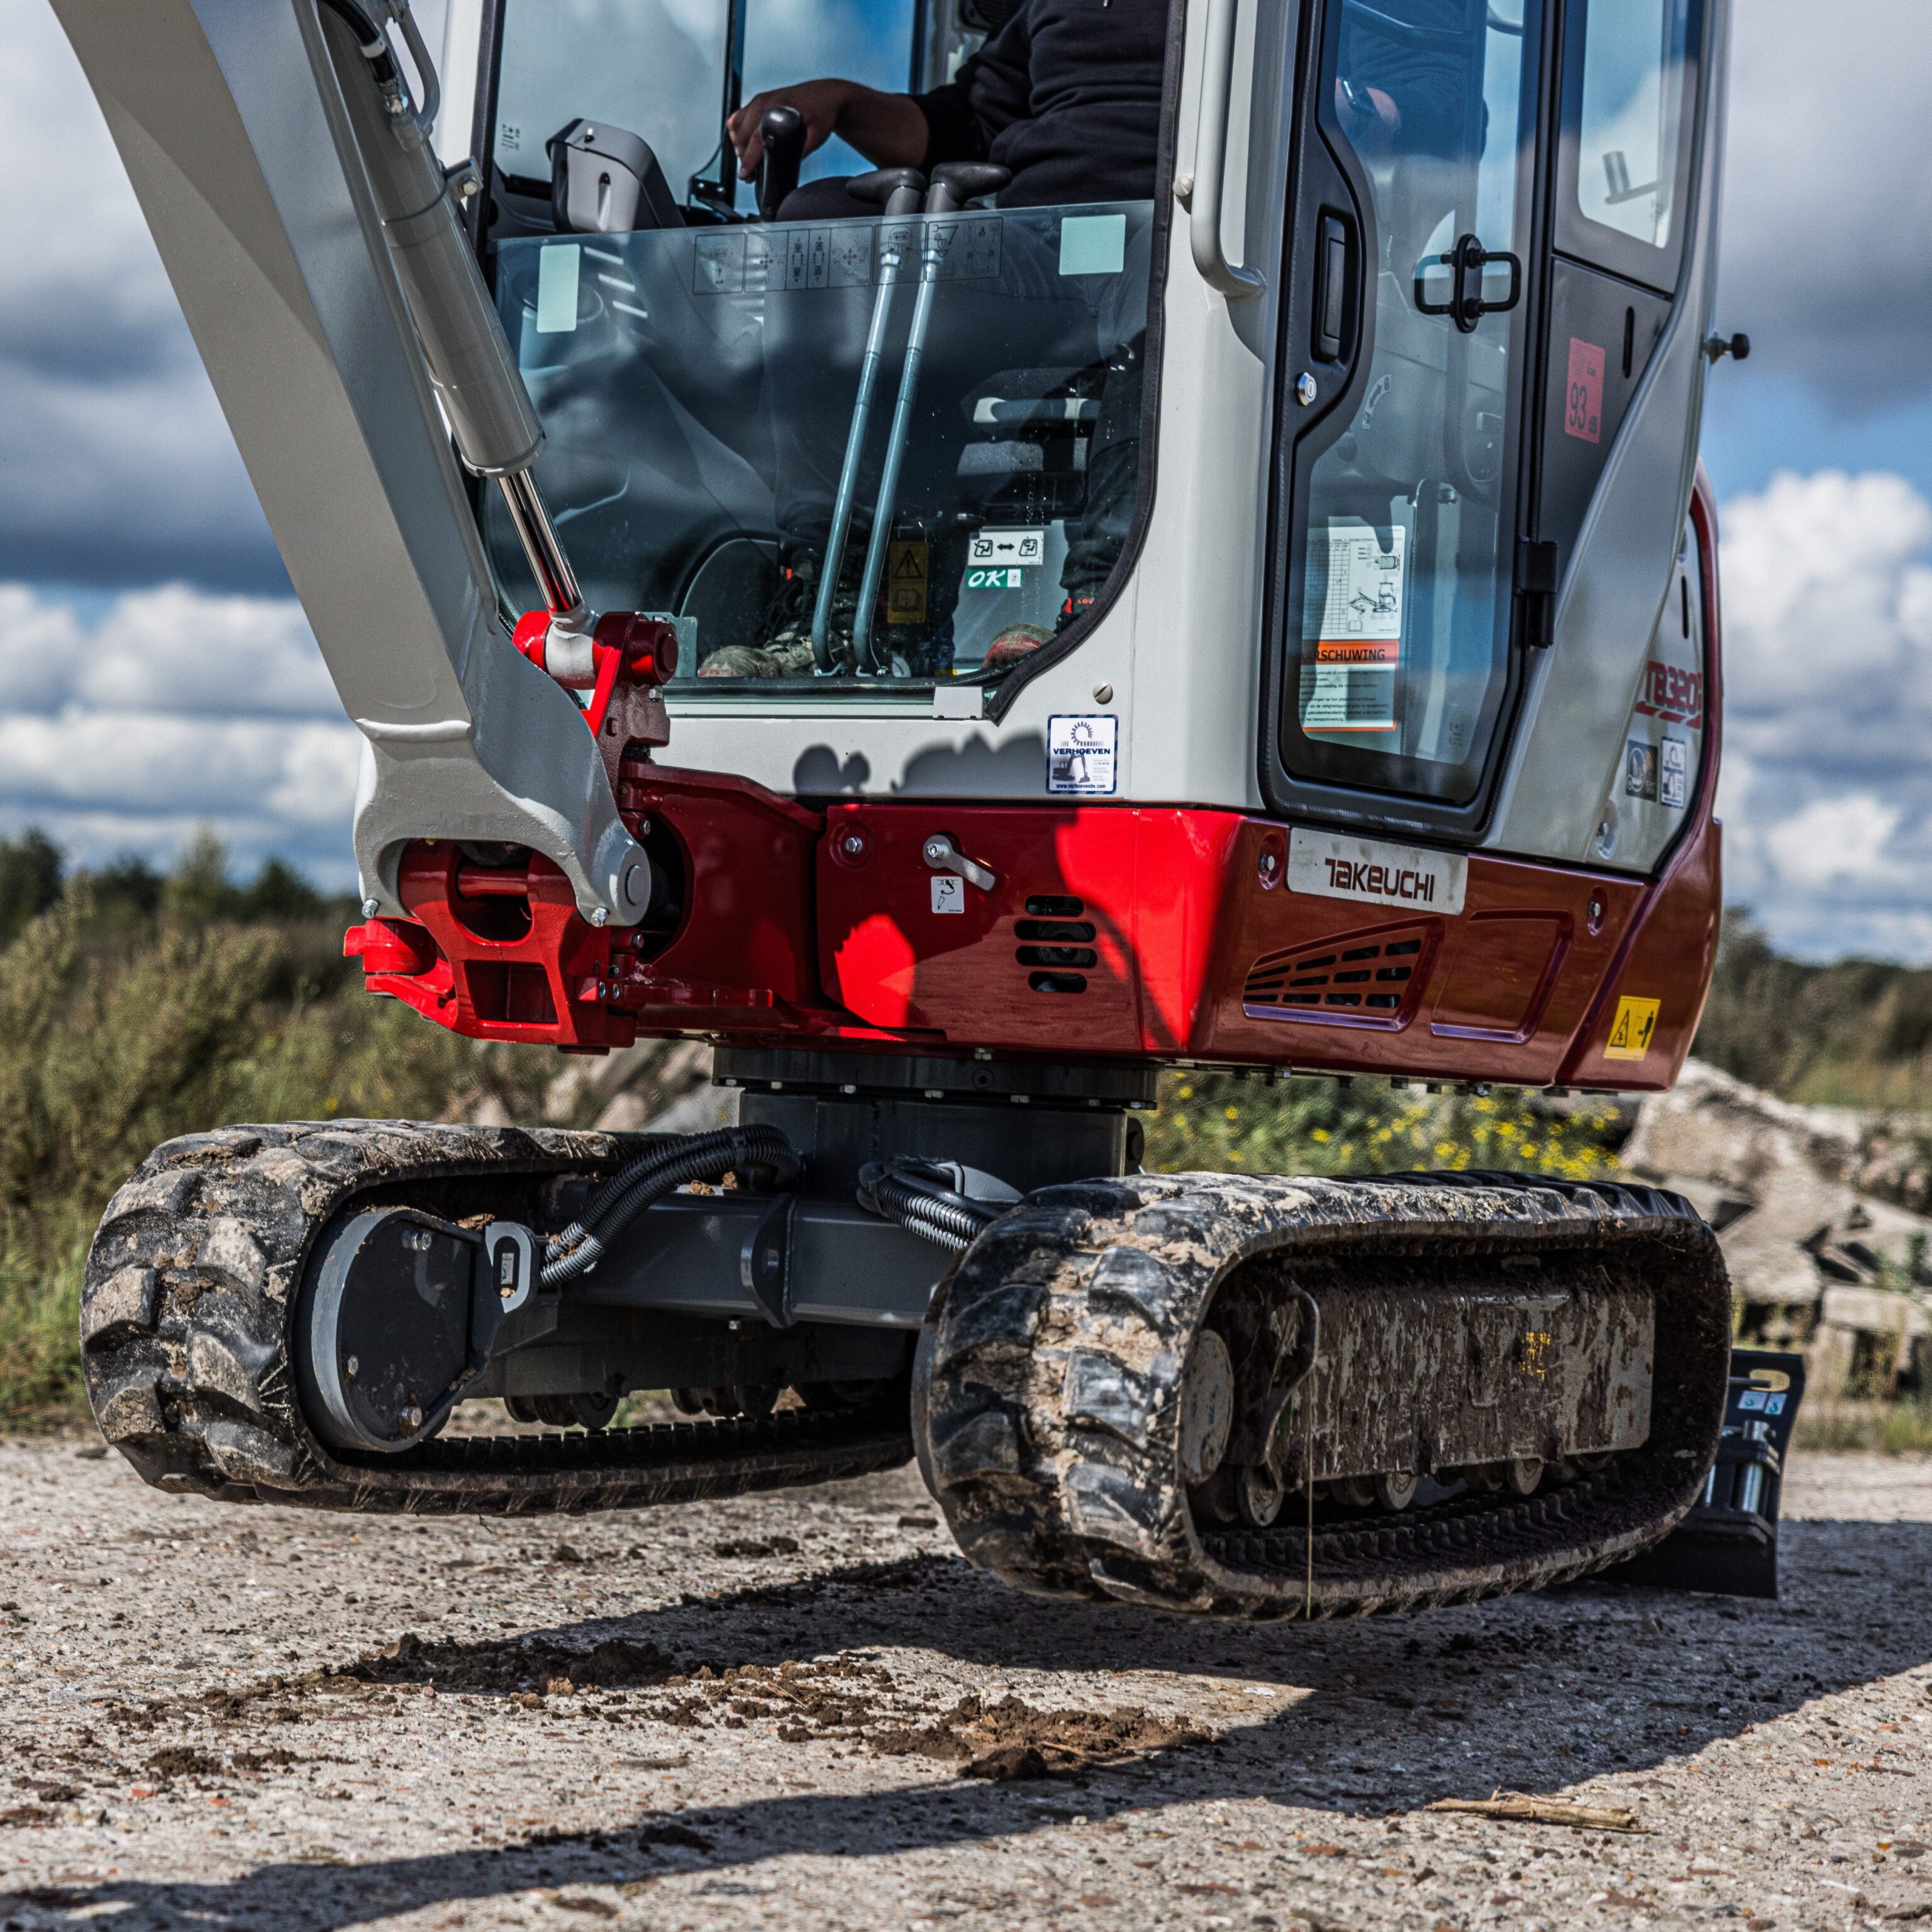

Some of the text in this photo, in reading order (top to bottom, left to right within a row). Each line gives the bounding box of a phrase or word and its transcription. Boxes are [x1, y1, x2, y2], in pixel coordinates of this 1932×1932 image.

[1569, 382, 1587, 430] 93
[968, 569, 1006, 587] OK
[1324, 858, 1435, 902] TAKEUCHI
